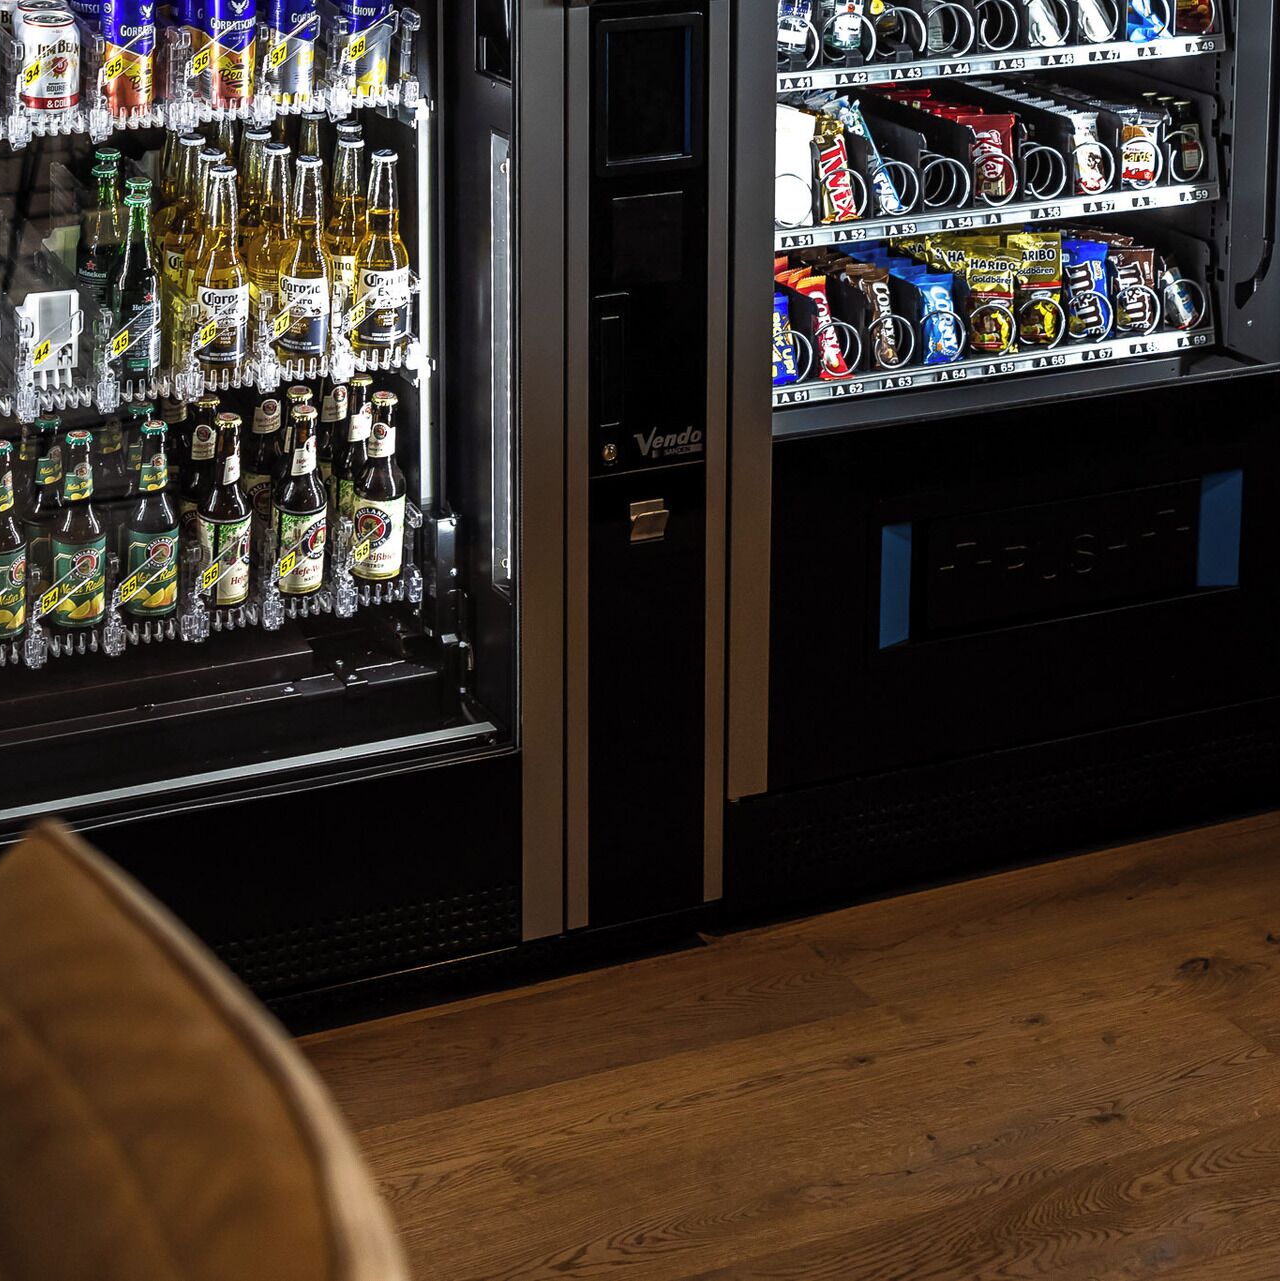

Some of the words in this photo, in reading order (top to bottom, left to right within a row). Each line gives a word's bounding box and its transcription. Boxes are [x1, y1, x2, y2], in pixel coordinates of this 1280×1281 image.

[352, 40, 365, 57] 38
[1191, 44, 1198, 52] A
[1202, 42, 1215, 50] 49
[194, 54, 208, 71] 36
[272, 47, 286, 65] 37
[26, 64, 41, 83] 34
[107, 60, 121, 78] 35
[943, 67, 951, 75] A
[956, 65, 969, 73] 44
[840, 75, 848, 83] A
[854, 73, 867, 82] 42
[55, 99, 72, 108] COL
[820, 134, 856, 221] TWIX
[890, 226, 898, 235] A
[902, 225, 916, 233] 53
[785, 237, 793, 246] A
[798, 236, 812, 245] 51
[1022, 249, 1056, 261] ARIBO
[970, 259, 1015, 270] HARIBO
[1017, 267, 1054, 276] oldbären
[276, 316, 288, 333] 47
[202, 324, 216, 341] 46
[114, 336, 128, 353] 45
[1181, 337, 1189, 346] A
[1194, 335, 1206, 344] 69
[35, 345, 49, 361] 44
[1040, 357, 1047, 366] A
[1052, 356, 1065, 365] 66
[941, 372, 948, 381] A
[953, 370, 966, 378] 64
[836, 387, 844, 395] A
[850, 384, 863, 393] 62
[633, 426, 702, 456] Vendo
[281, 556, 295, 572] 57
[204, 569, 218, 584] 56
[122, 580, 136, 596] 55
[44, 591, 57, 608] 54
